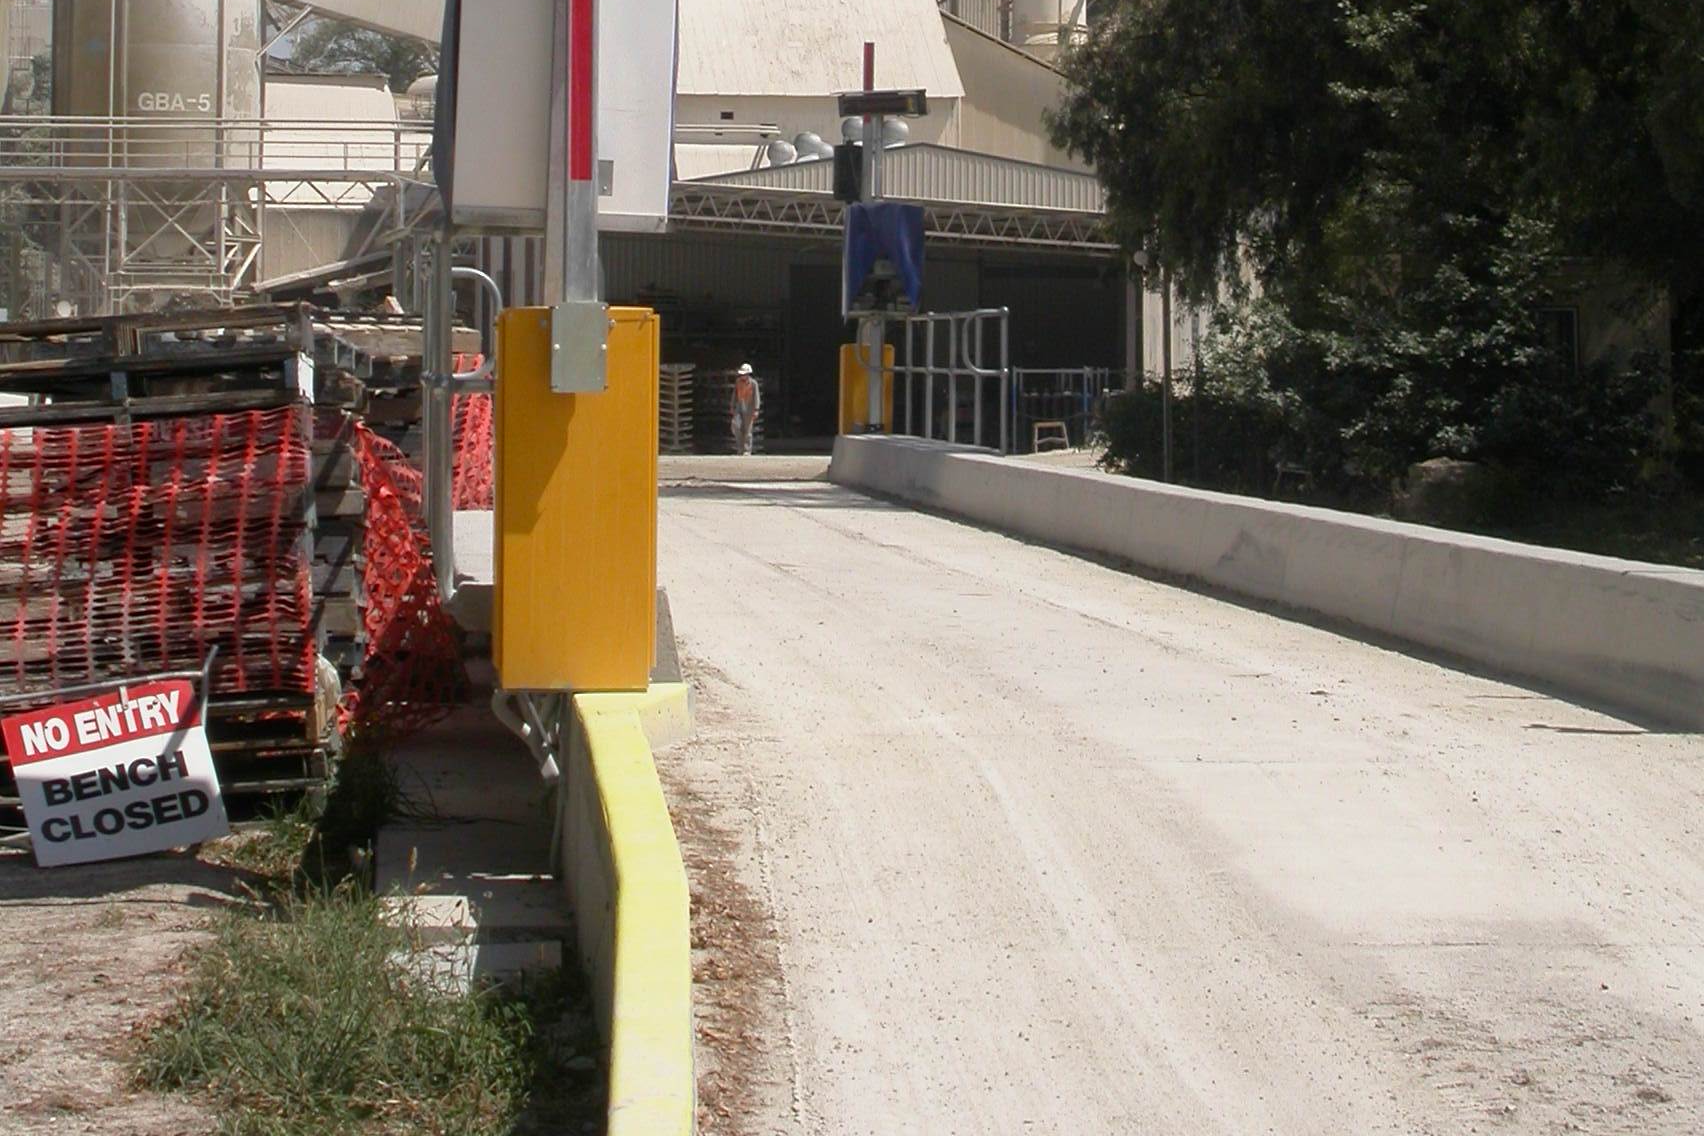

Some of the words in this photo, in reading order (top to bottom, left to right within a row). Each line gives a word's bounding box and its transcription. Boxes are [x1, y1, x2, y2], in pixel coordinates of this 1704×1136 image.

[138, 92, 211, 112] GBA-5
[20, 717, 70, 756] NO
[74, 690, 180, 745] ENTRY
[42, 750, 189, 807] BENCH
[41, 789, 209, 843] CLOSED
